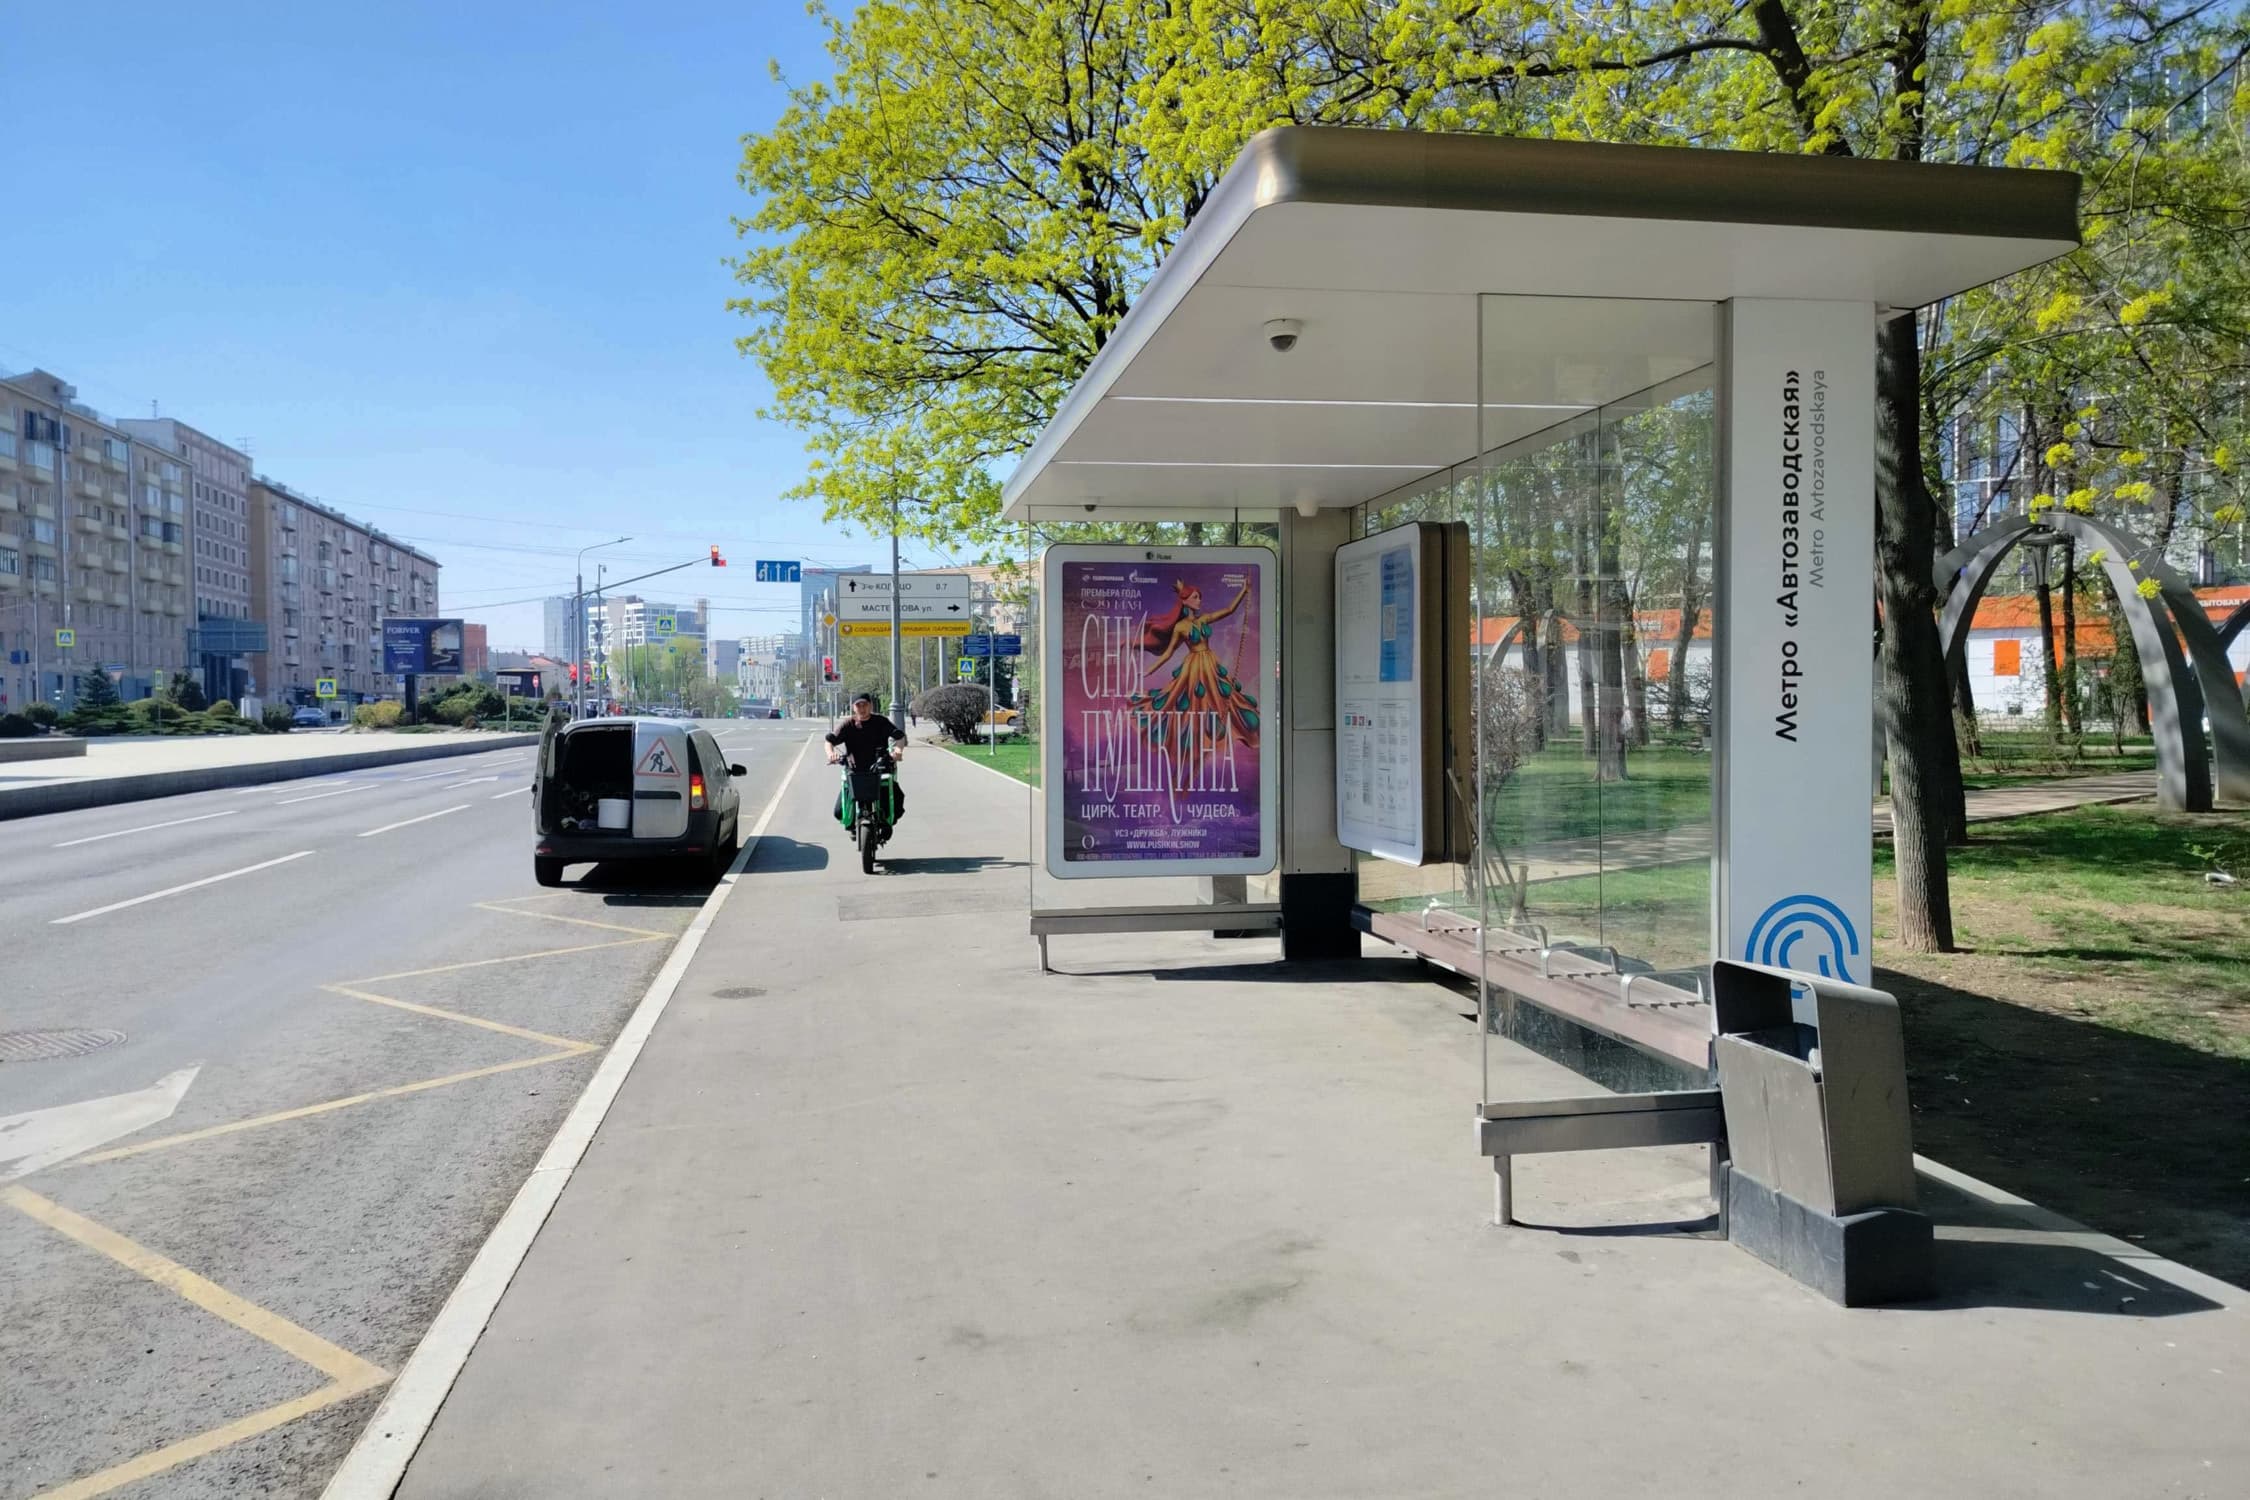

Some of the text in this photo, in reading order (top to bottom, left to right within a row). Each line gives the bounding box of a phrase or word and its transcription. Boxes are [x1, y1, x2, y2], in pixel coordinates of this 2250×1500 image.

[1809, 369, 1828, 589] Metro Avtozavodskaya
[1775, 370, 1803, 743] Метро «Автозаводская»
[1081, 588, 1142, 599] ПРЕМЬЕРА ГОДА
[1081, 611, 1148, 699] СНЫ
[1081, 709, 1239, 824] ПУШКИНА
[1081, 804, 1240, 820] ЦИРК. ТЕАТР. ЧУДЕСА.
[1171, 829, 1207, 837] ЛУЖНИКИ
[1126, 840, 1201, 849] WWW.PUSHKIN.SHOW
